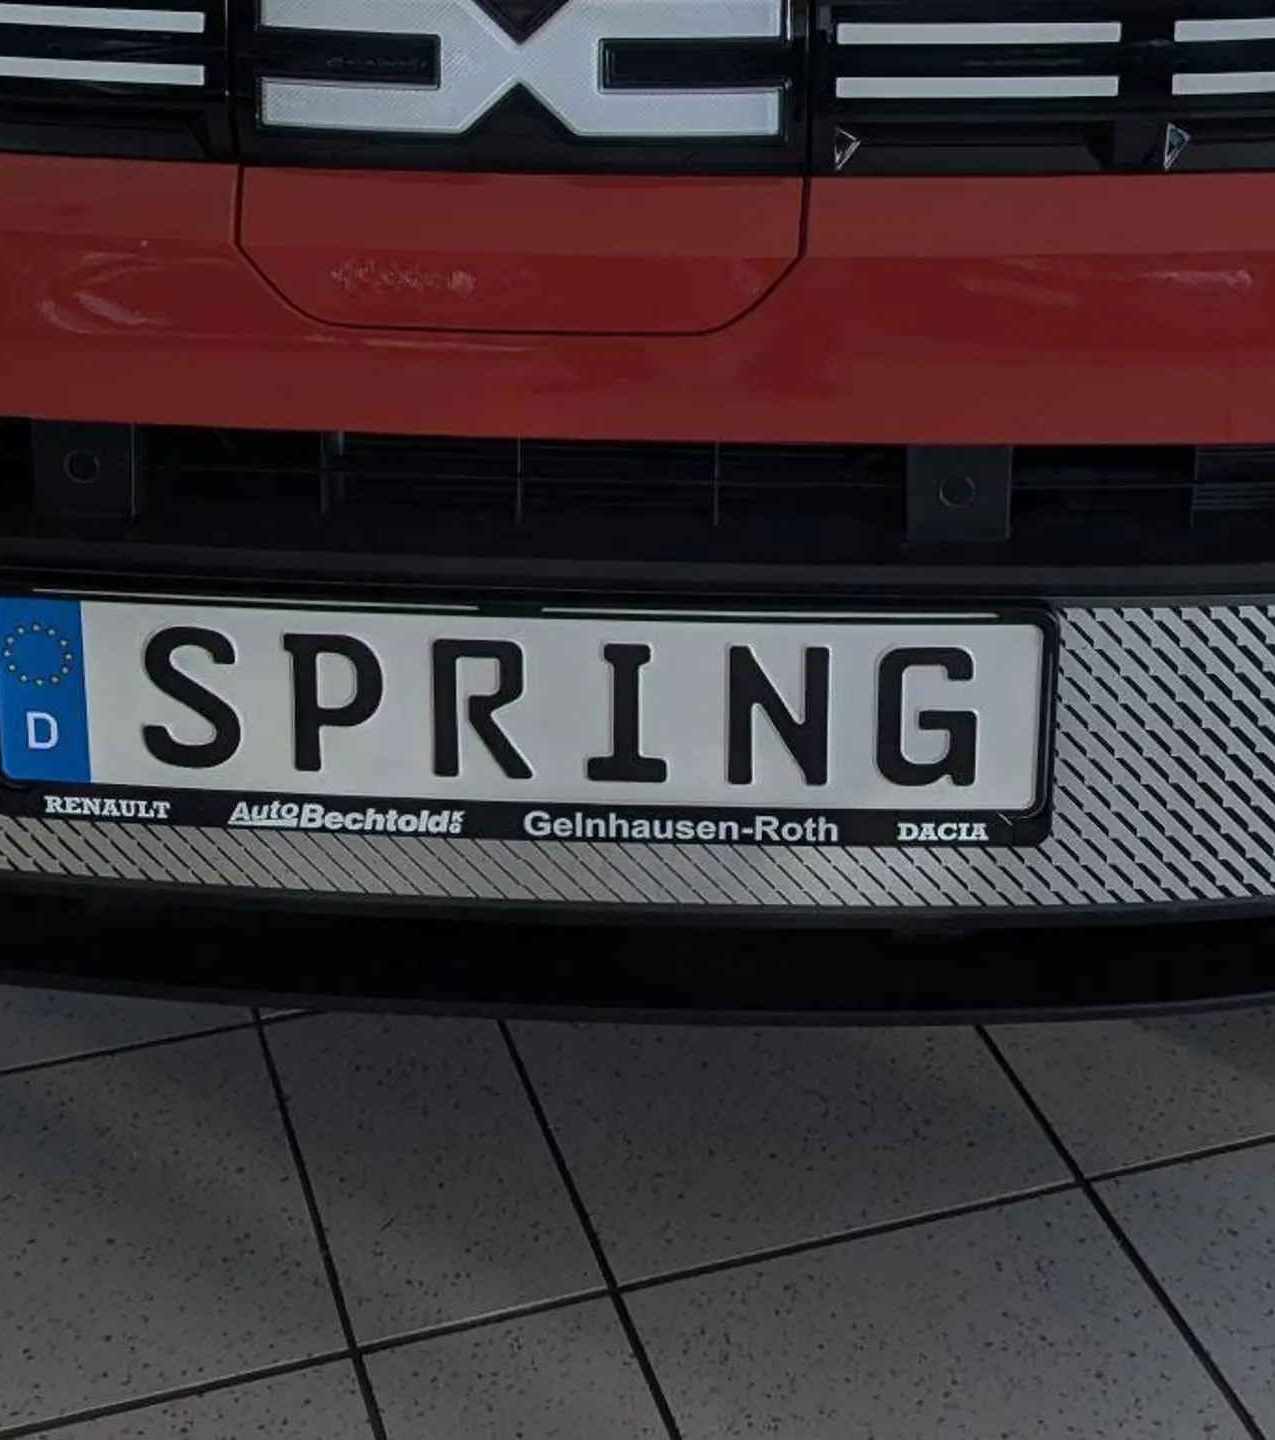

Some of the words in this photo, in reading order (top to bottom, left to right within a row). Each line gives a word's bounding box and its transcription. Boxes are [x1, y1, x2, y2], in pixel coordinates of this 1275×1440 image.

[26, 711, 59, 750] D
[142, 626, 978, 787] SPRING
[44, 795, 170, 819] RENAULT
[524, 811, 839, 843] Gelnhausen-Roth
[897, 822, 989, 842] DACIA
